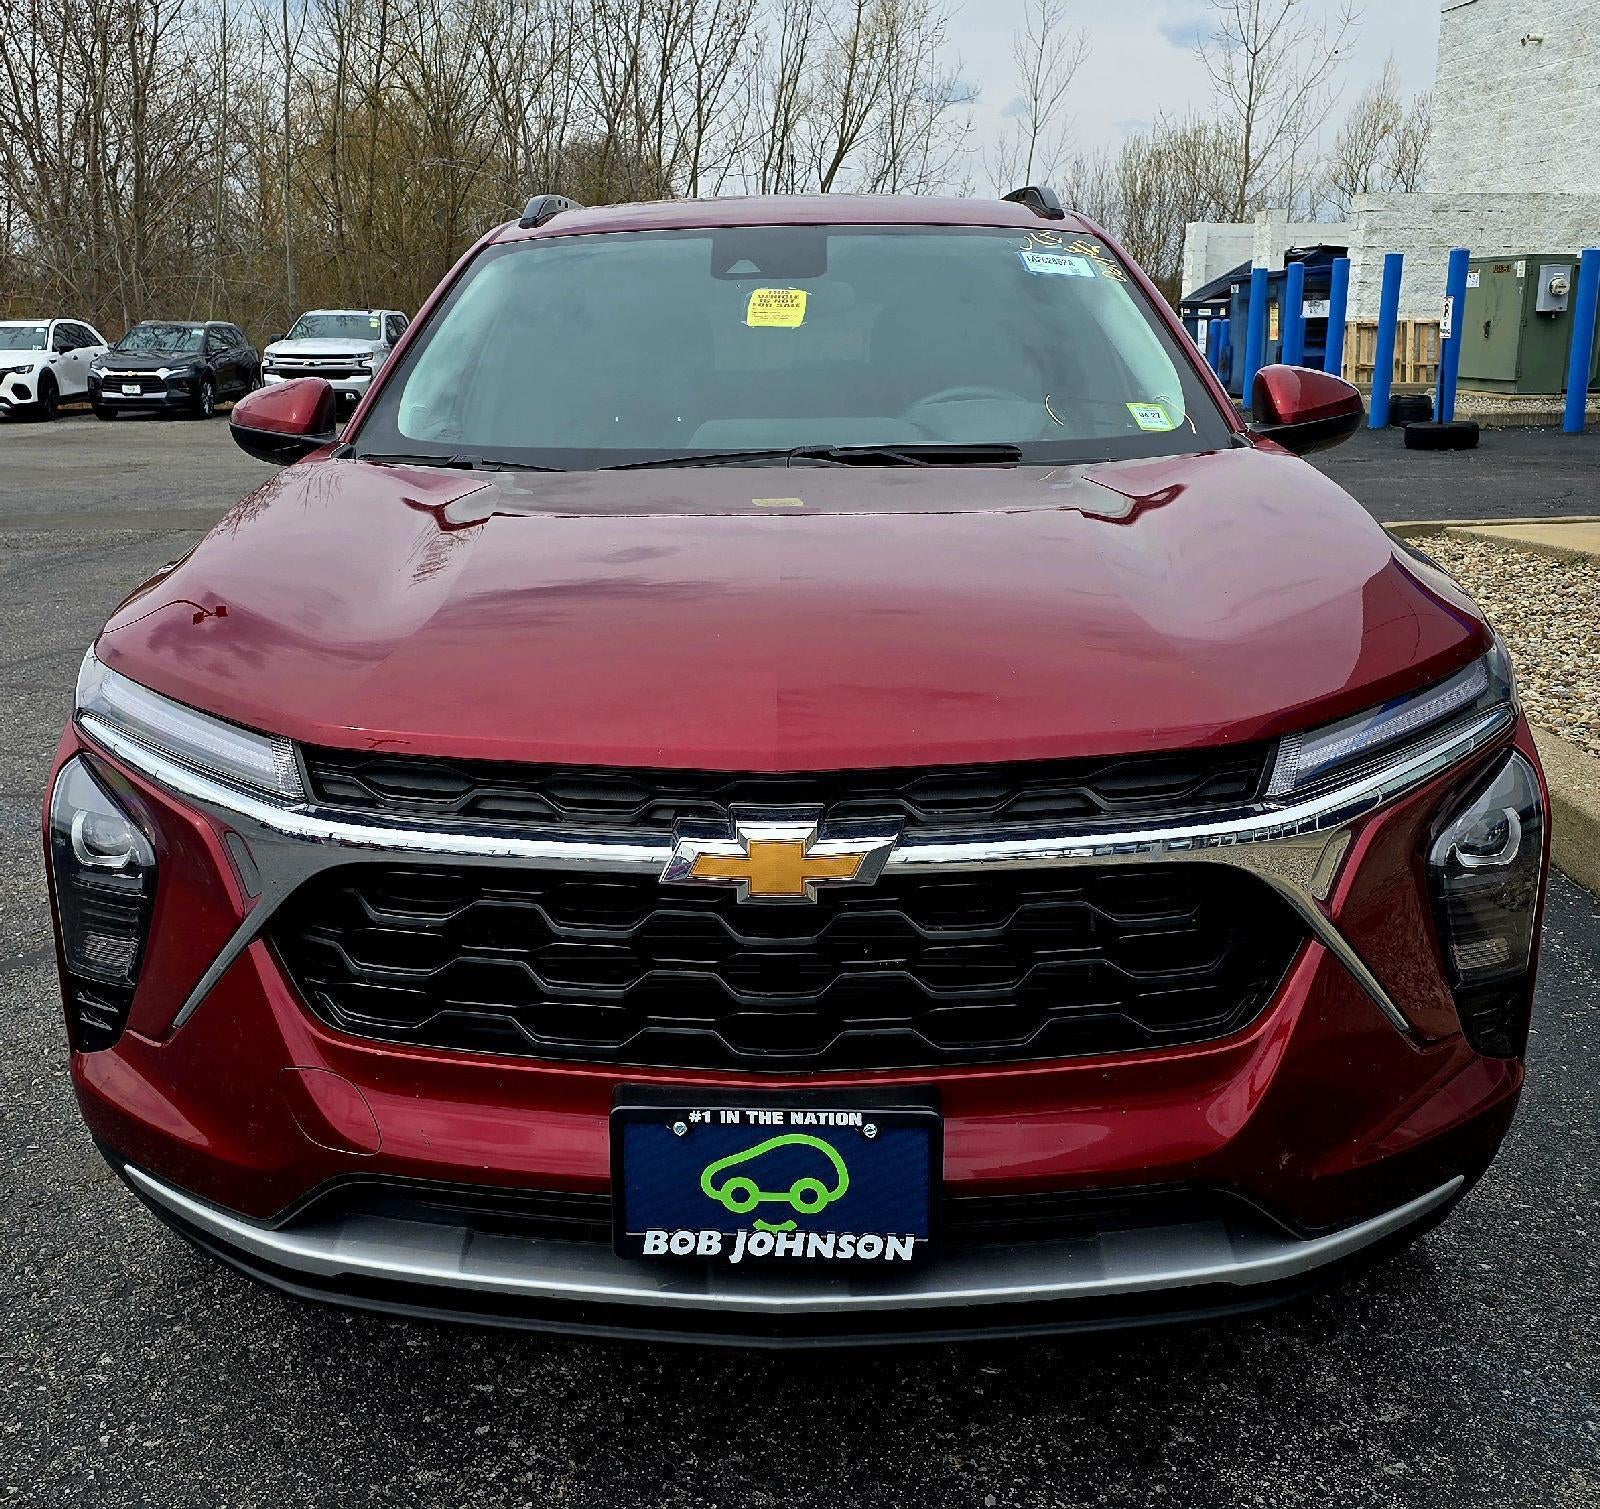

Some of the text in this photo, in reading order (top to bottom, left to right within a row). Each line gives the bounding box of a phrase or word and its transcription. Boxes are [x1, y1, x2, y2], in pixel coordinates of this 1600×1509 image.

[689, 1111, 863, 1126] #1 IN THE NATION
[643, 1230, 915, 1263] BOB JOHNSON
